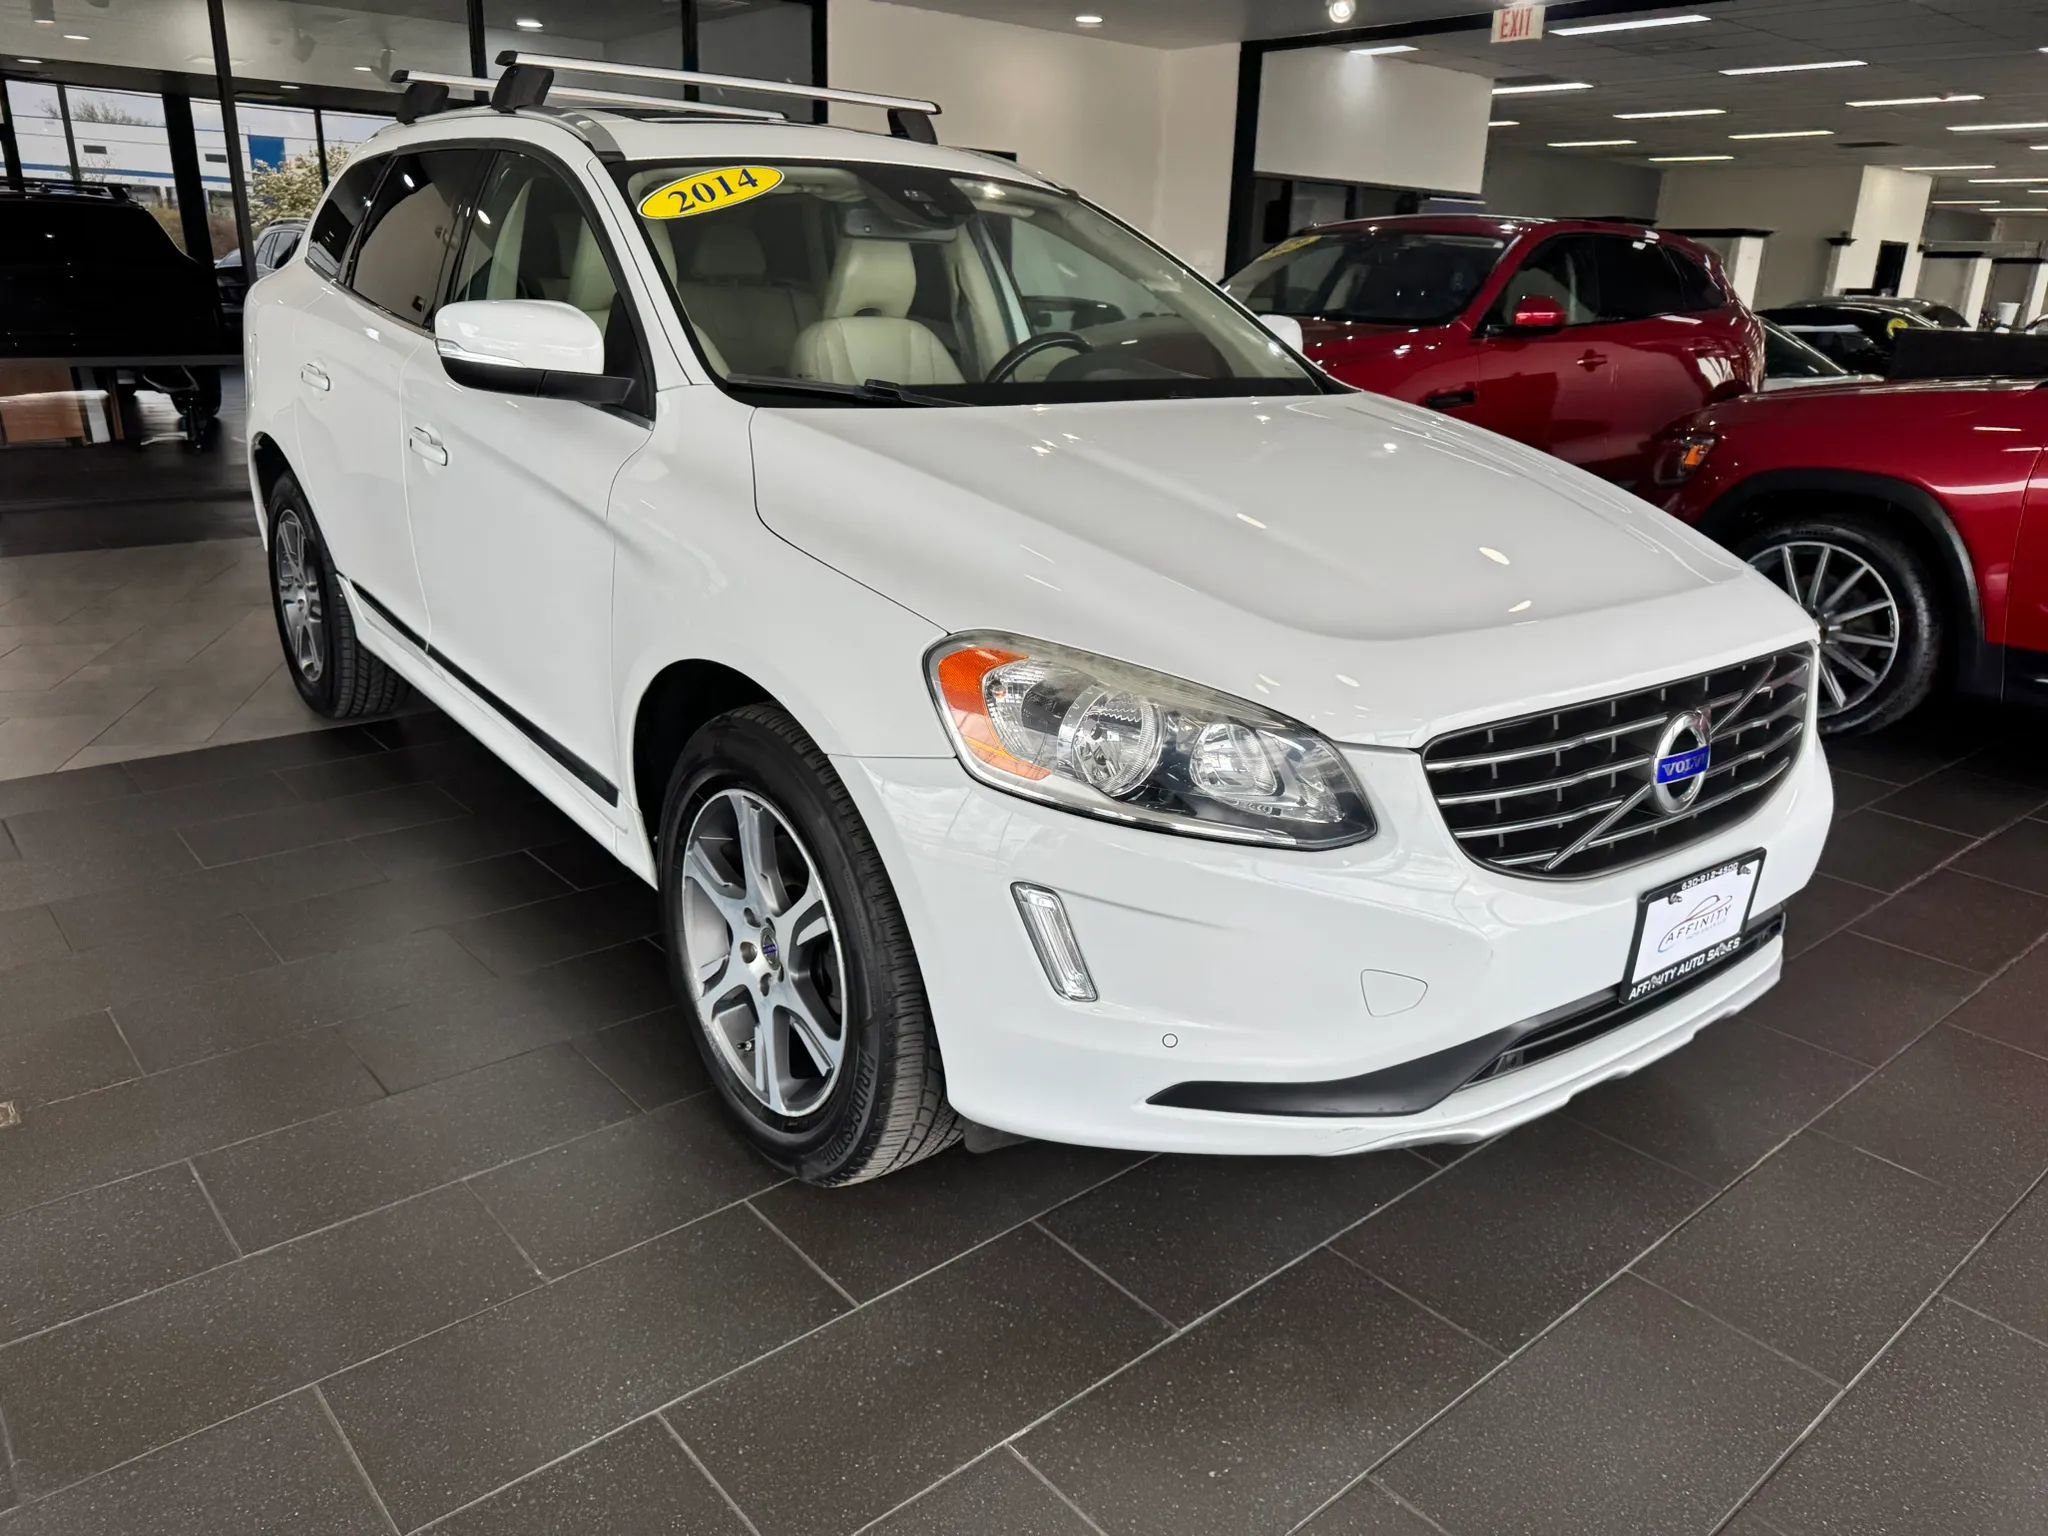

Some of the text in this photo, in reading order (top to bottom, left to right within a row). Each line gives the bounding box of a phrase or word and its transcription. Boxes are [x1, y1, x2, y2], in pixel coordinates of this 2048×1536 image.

[1500, 8, 1533, 39] EXIT
[668, 168, 758, 213] 2014
[1665, 904, 1732, 944] AFFINITY
[1677, 954, 1705, 976] AUTO
